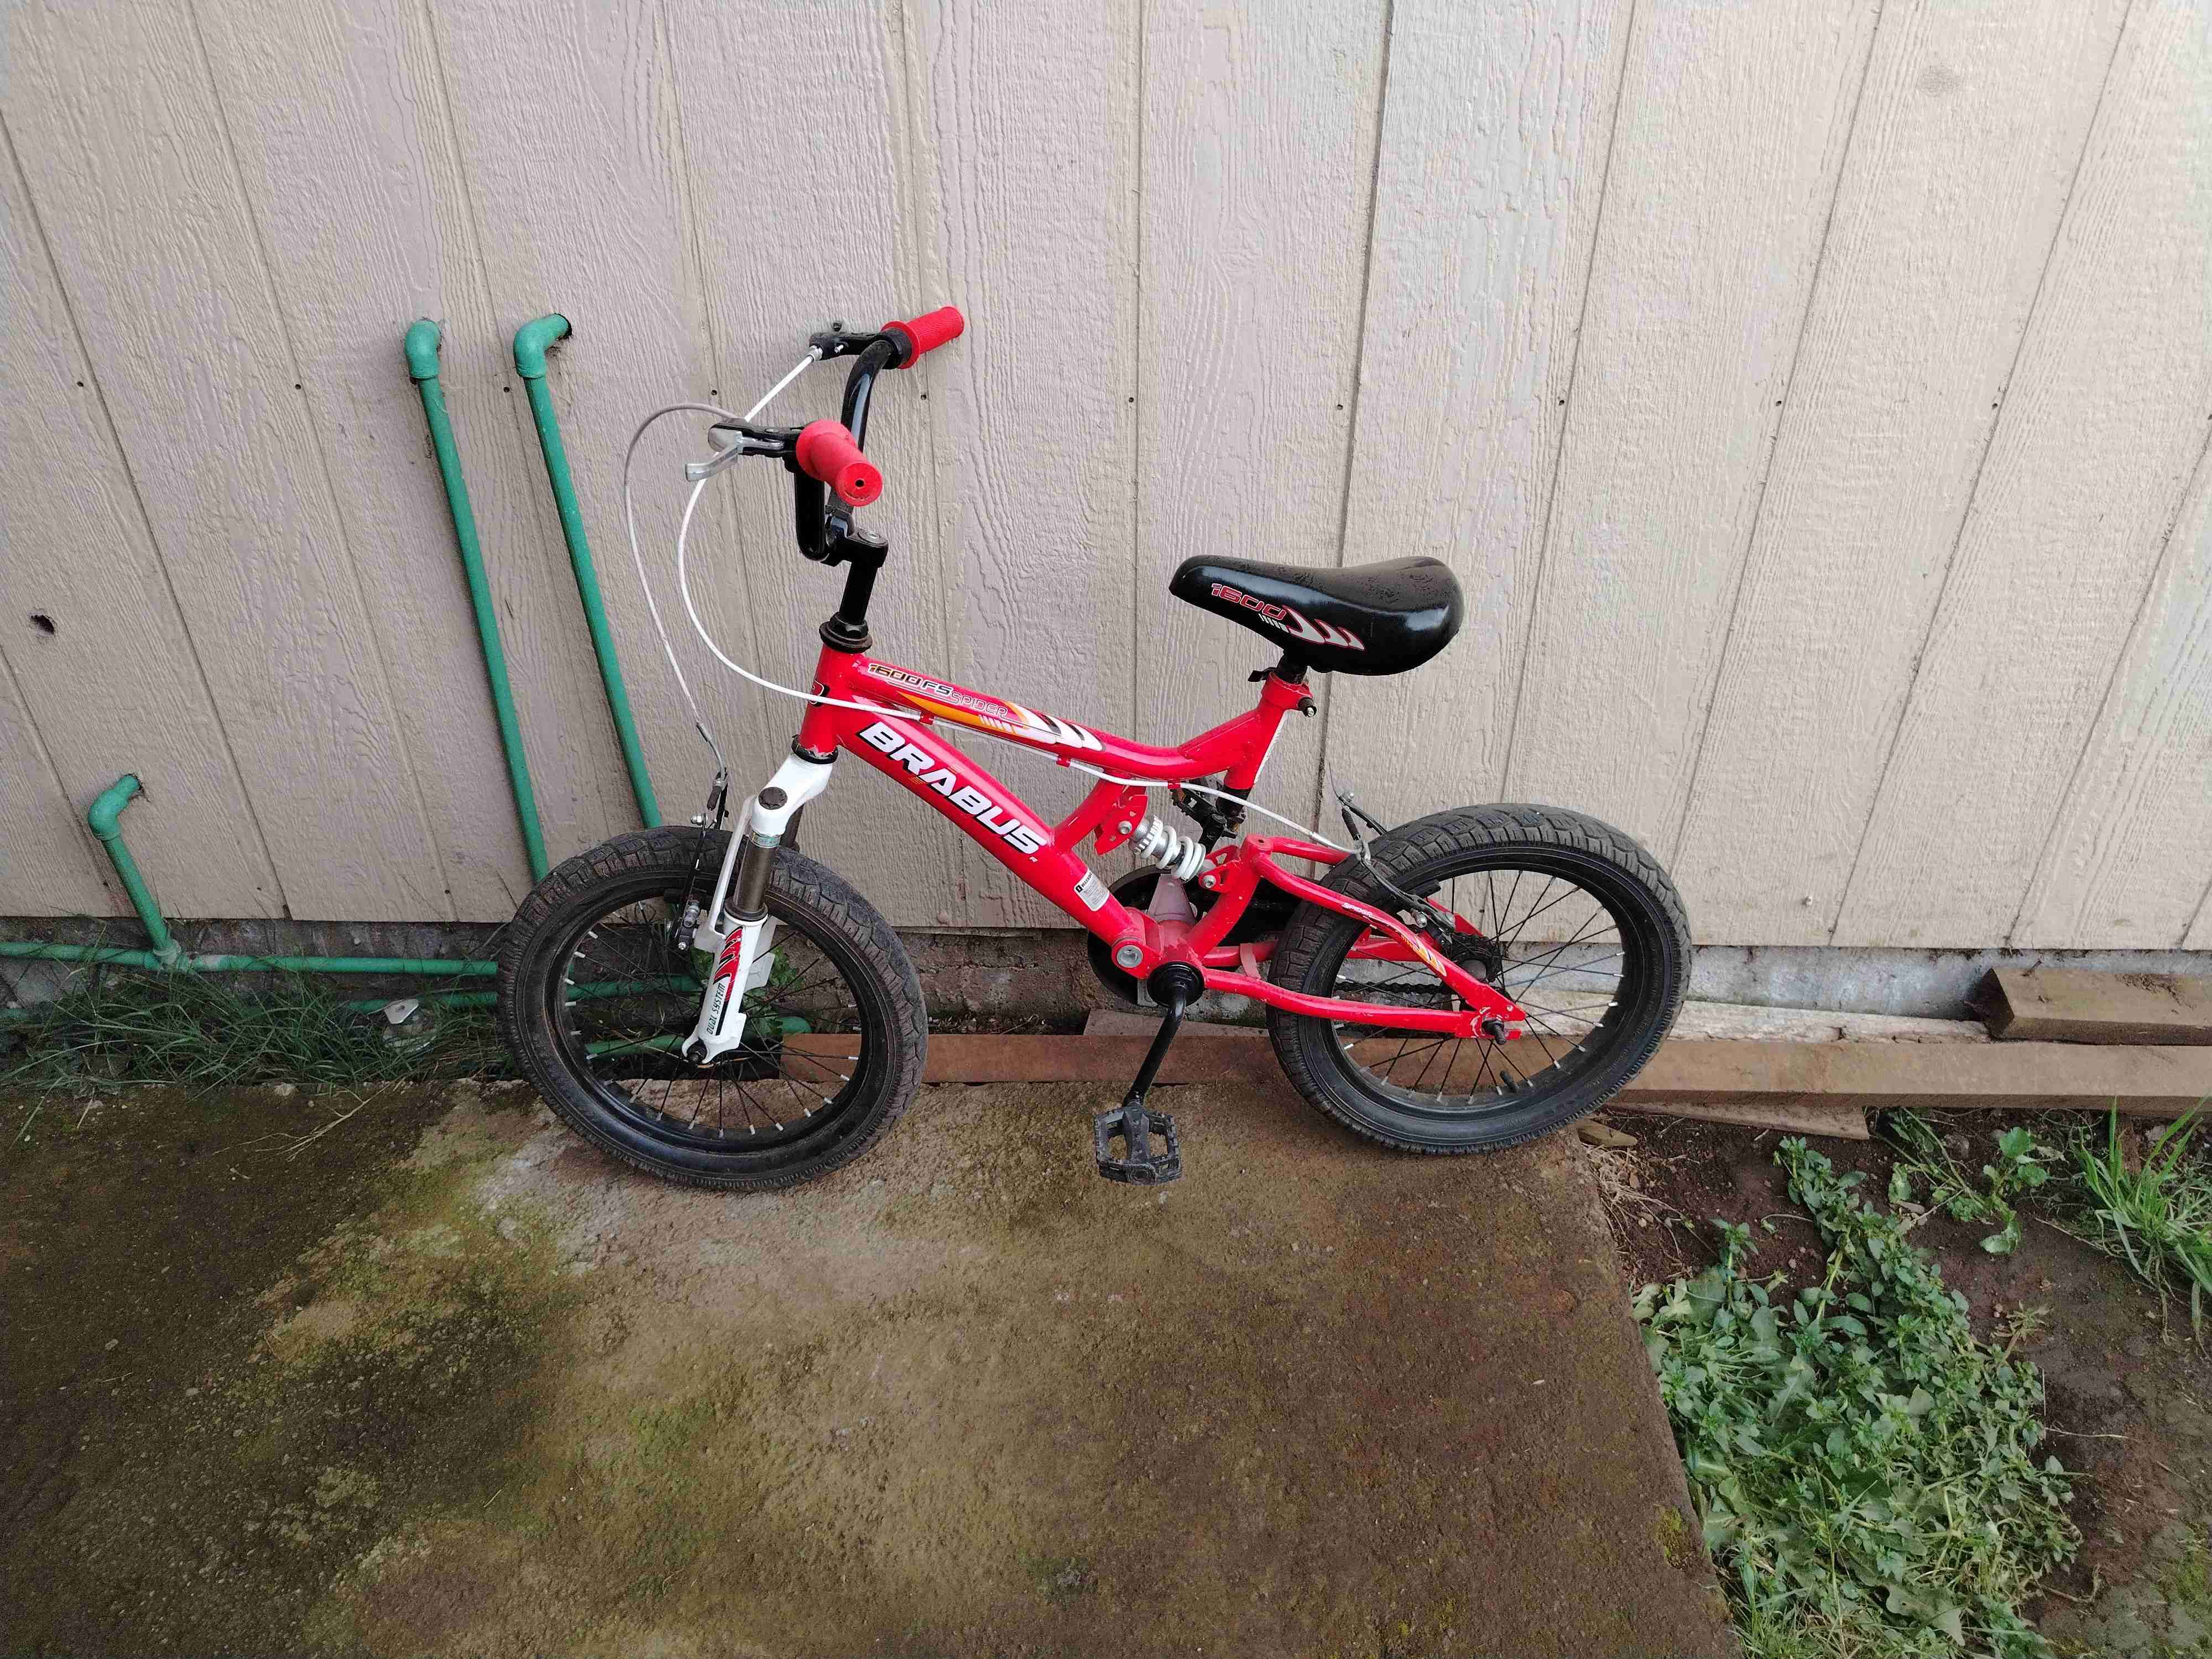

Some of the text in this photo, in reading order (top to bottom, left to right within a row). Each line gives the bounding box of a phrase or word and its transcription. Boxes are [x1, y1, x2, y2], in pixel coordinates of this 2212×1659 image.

[951, 691, 1008, 718] SPIDER
[857, 721, 1047, 854] BRABUS
[712, 982, 726, 1014] SYSTEM
